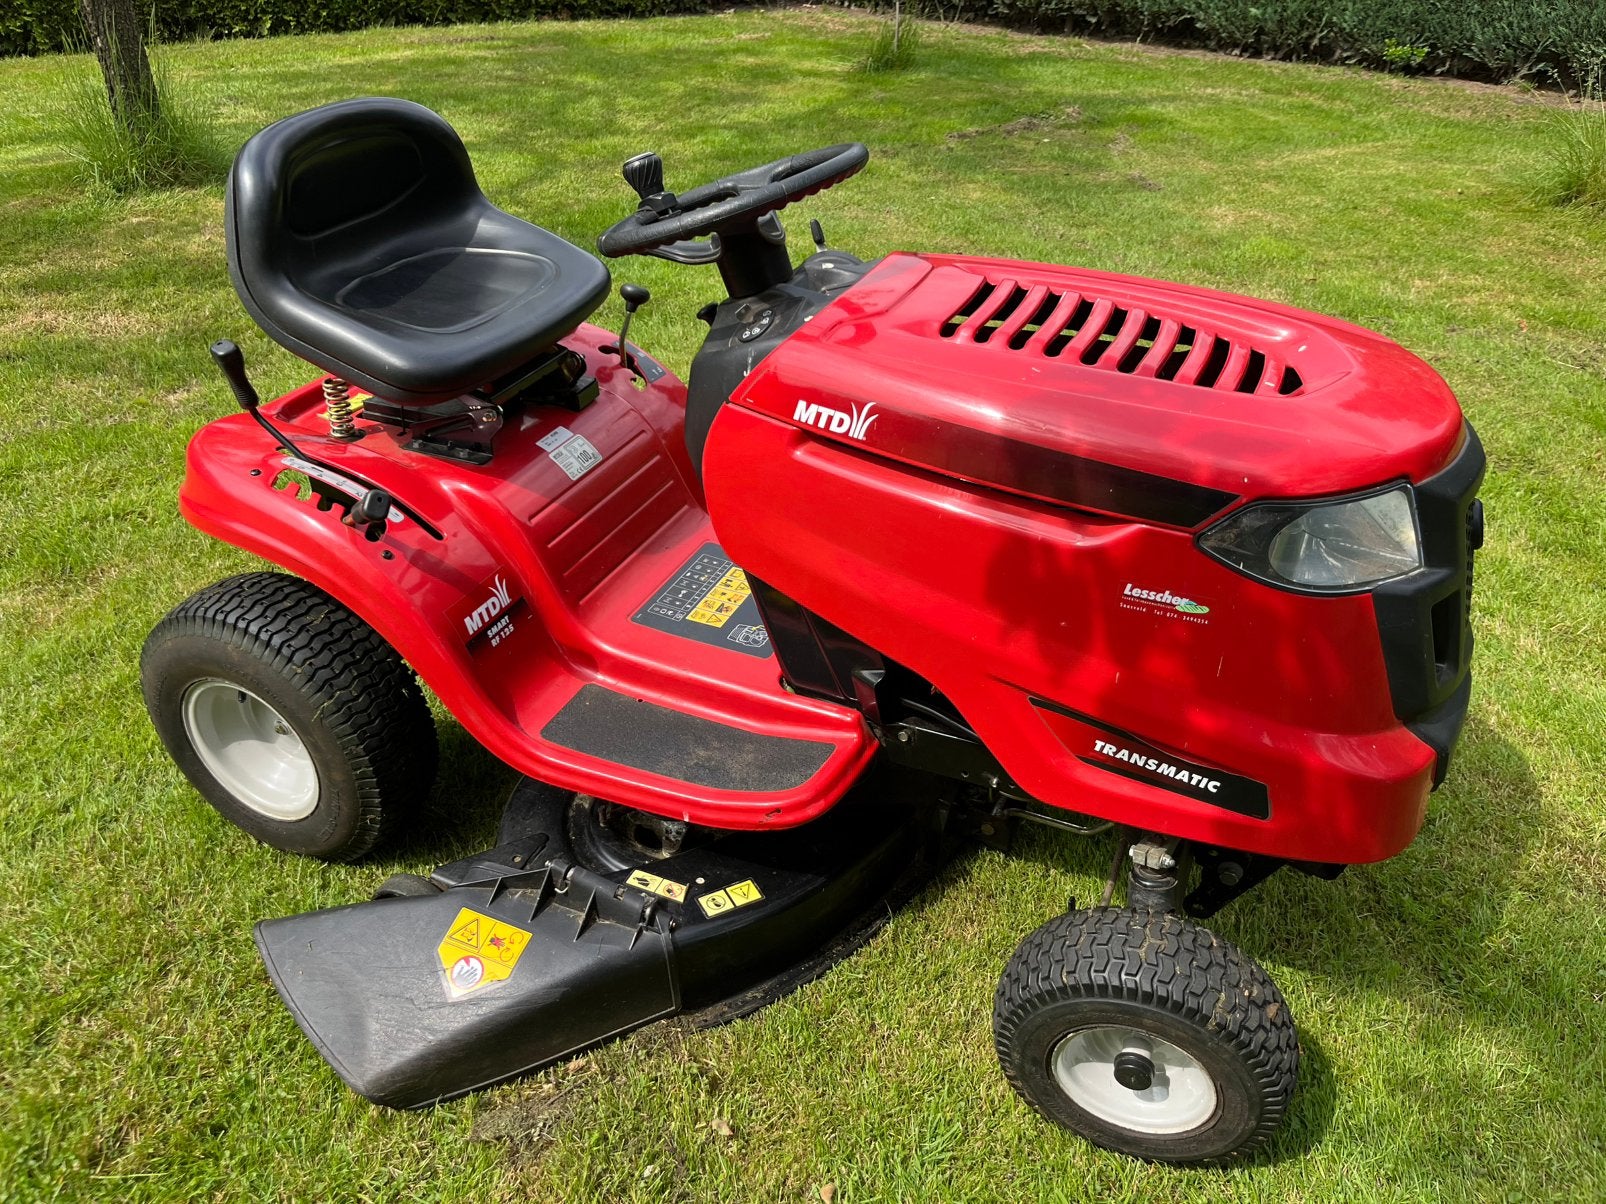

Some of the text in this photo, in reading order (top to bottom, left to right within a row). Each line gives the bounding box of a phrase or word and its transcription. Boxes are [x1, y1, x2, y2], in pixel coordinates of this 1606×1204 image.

[793, 399, 851, 434] MTD
[577, 449, 592, 464] 100
[1124, 583, 1189, 606] Lesscher
[463, 596, 501, 636] MTD
[486, 615, 510, 638] SMART
[491, 623, 515, 647] RF 125
[1093, 739, 1221, 793] TRANSMATIC
